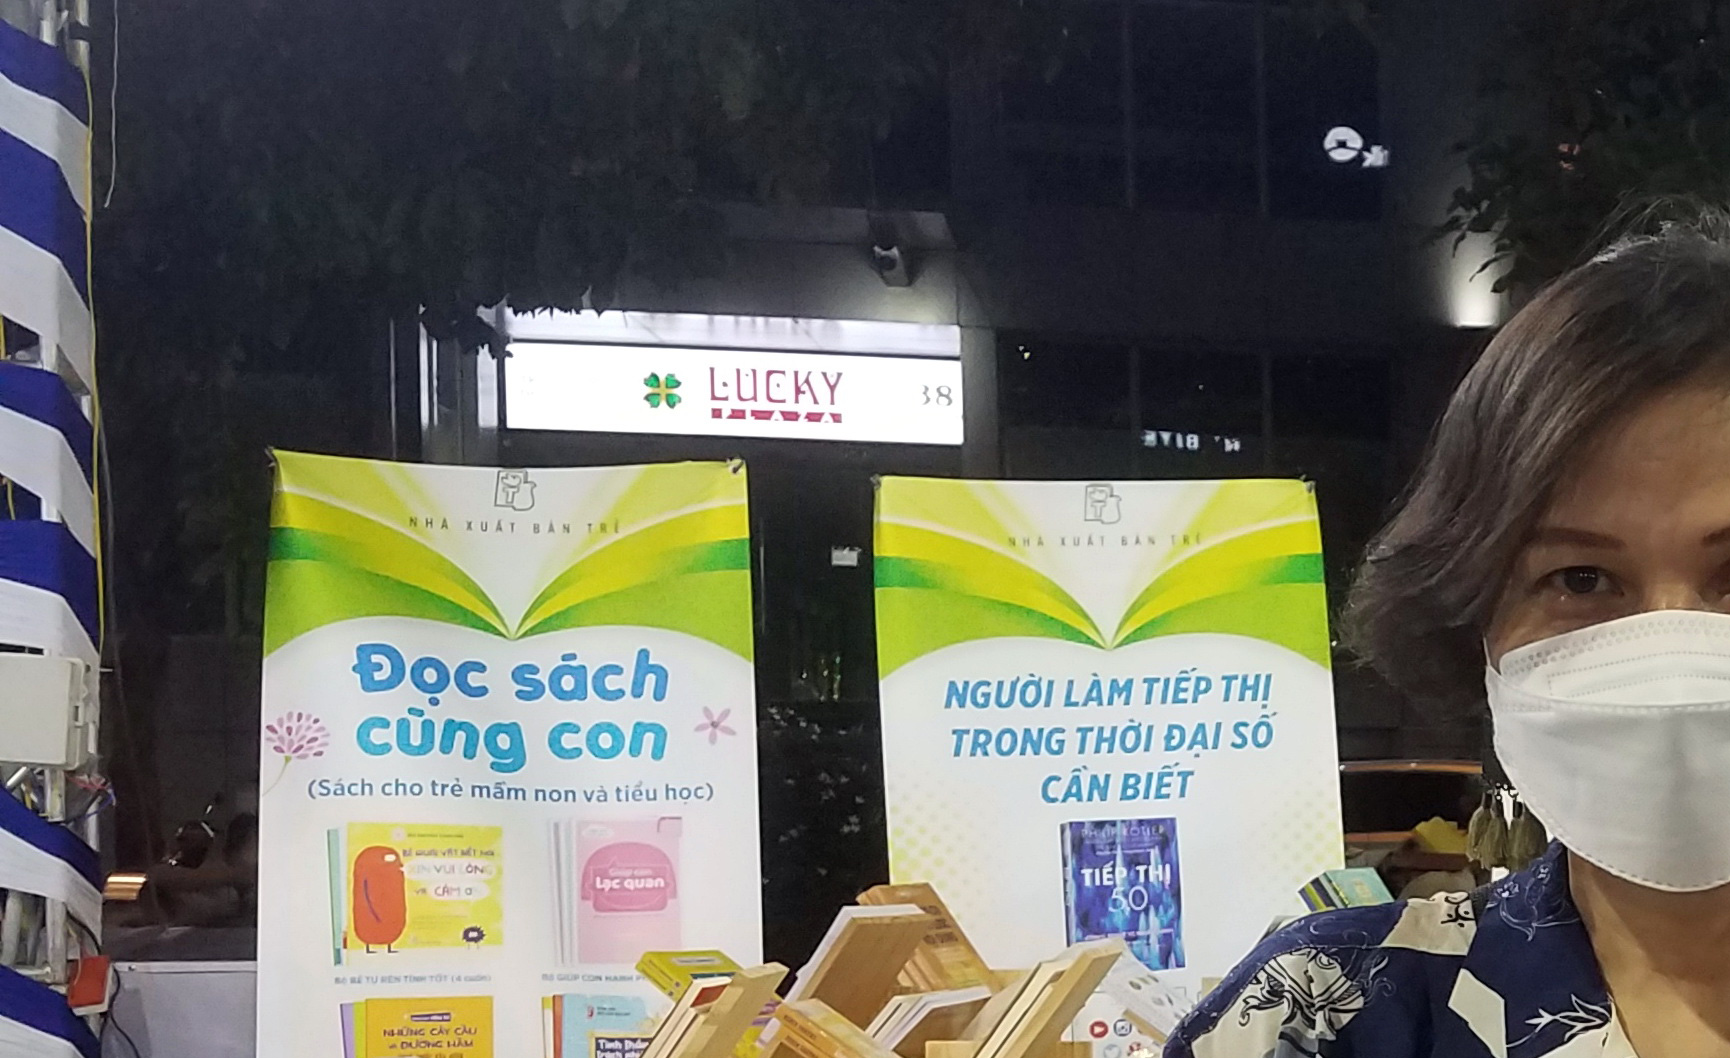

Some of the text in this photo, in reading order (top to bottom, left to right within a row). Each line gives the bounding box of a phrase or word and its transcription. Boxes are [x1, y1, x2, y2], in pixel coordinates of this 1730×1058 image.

[710, 367, 843, 405] LUCKY
[352, 643, 669, 706] Đọc sách
[944, 667, 1272, 709] NGƯỜI LÀM TIẾP THỊ
[356, 707, 668, 773] cùng con
[951, 712, 1280, 758] TRONG THỜI ĐẠI SỐ
[308, 778, 714, 806] (Sách cho trẻ mầm non và tiểu học)
[1040, 763, 1195, 803] CẦN BIẾT
[596, 877, 665, 893] Lạc quan
[1080, 860, 1171, 889] TIẾP THỊ
